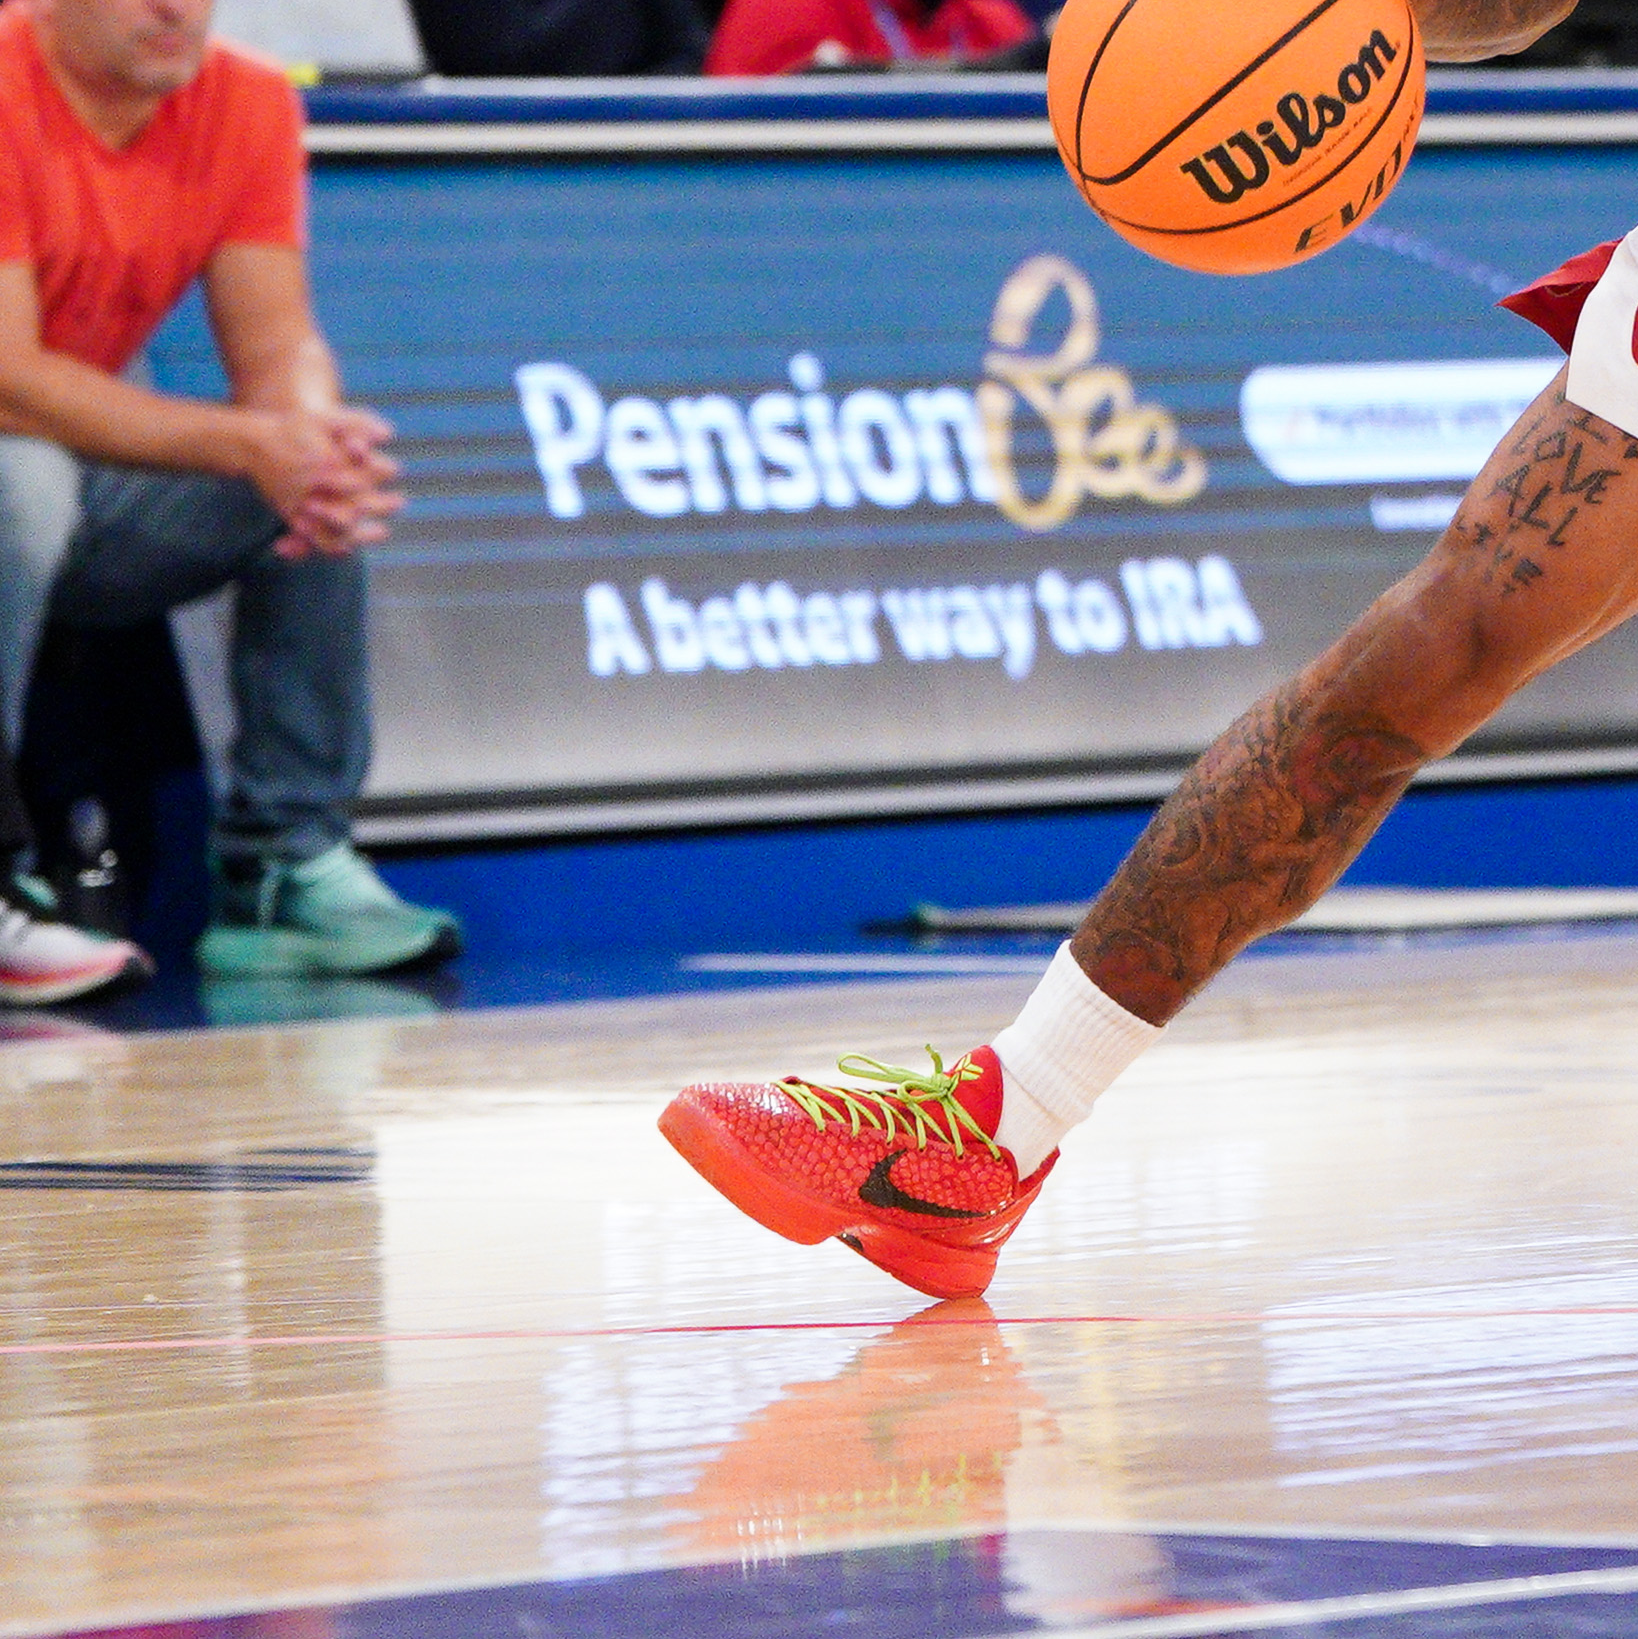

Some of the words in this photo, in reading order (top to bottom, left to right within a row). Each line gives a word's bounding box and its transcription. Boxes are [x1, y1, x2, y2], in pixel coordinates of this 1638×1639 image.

[1178, 27, 1398, 205] Wilson
[583, 580, 651, 676] A
[639, 575, 881, 673] better
[879, 580, 1036, 680] way
[1035, 567, 1127, 654] to
[1119, 554, 1265, 650] IRA
